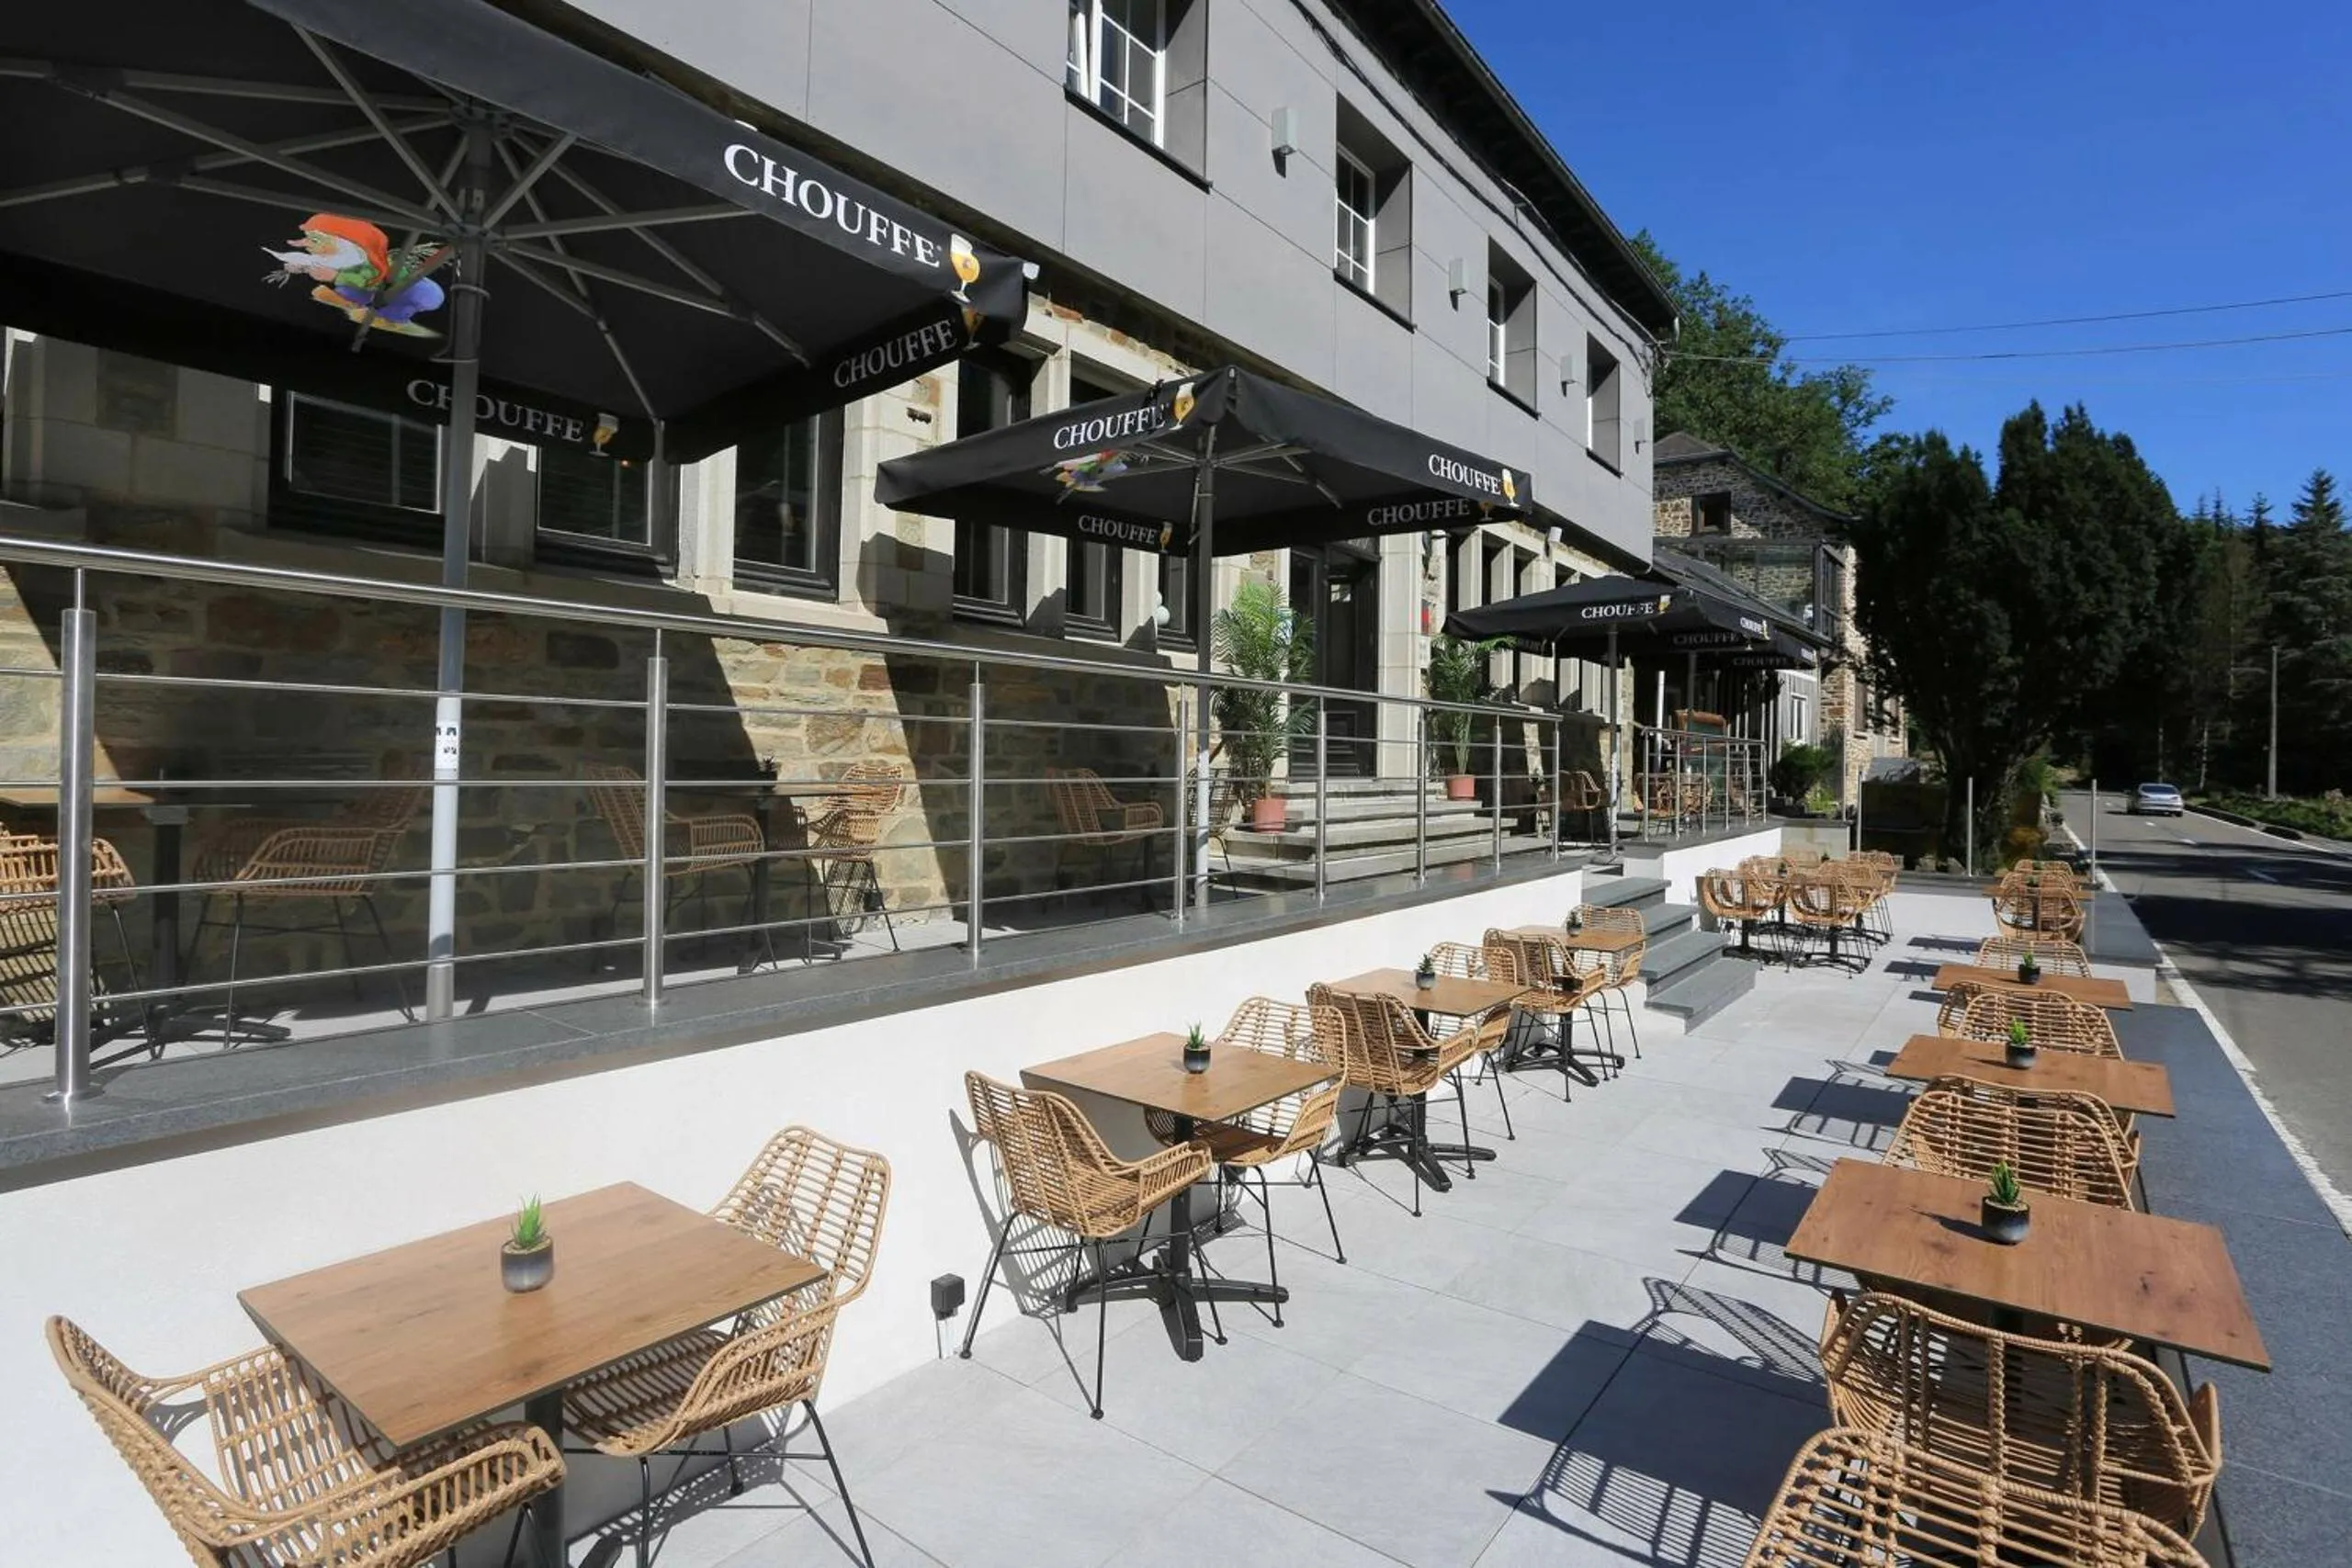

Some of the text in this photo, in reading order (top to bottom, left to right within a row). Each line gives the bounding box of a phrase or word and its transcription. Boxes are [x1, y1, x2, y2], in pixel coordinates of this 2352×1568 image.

[724, 143, 941, 268] CHOUFFE
[833, 320, 957, 389] CHOUFFE
[1428, 454, 1501, 495] CHOUFFE
[1079, 514, 1157, 545] CHOUFFE
[1367, 499, 1470, 526] CHOUFFE
